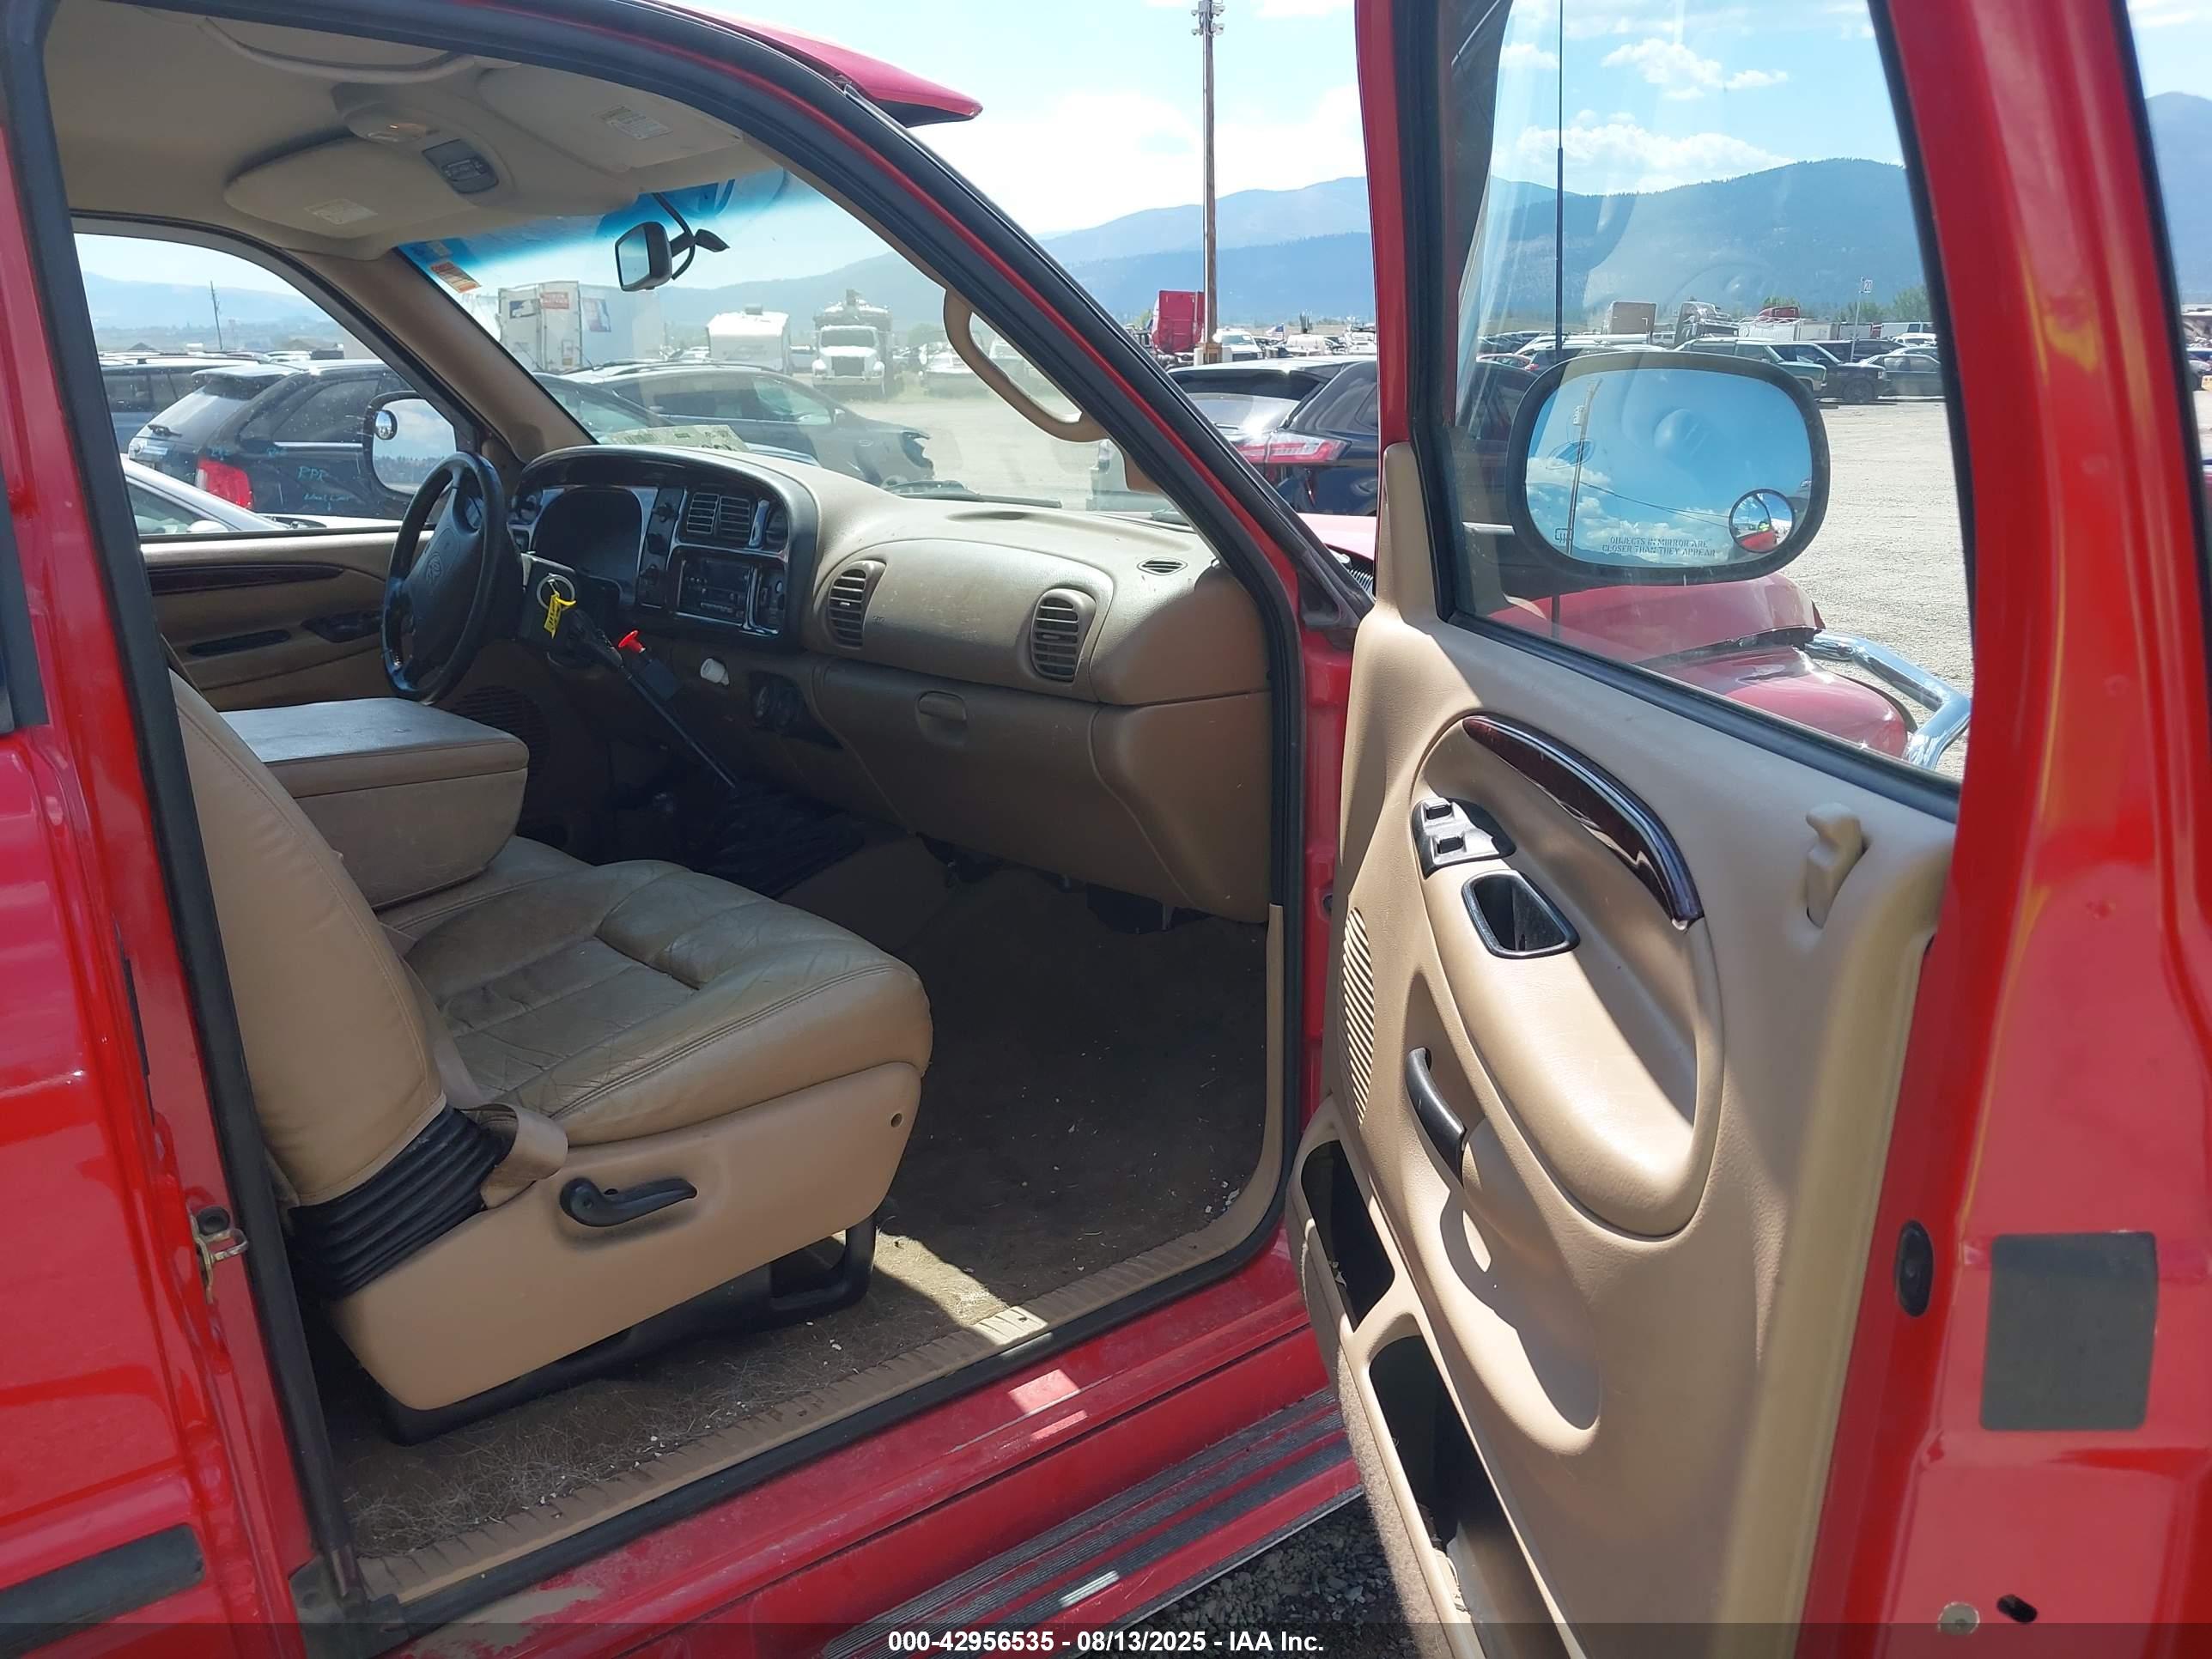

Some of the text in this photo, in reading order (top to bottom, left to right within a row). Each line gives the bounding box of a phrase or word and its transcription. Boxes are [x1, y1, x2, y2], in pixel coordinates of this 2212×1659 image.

[1610, 536, 1708, 548] OBJECTS IN MIRROR ARE
[1634, 545, 1656, 554] THAN
[1658, 546, 1680, 556] THEY
[1681, 547, 1716, 556] APPEAR
